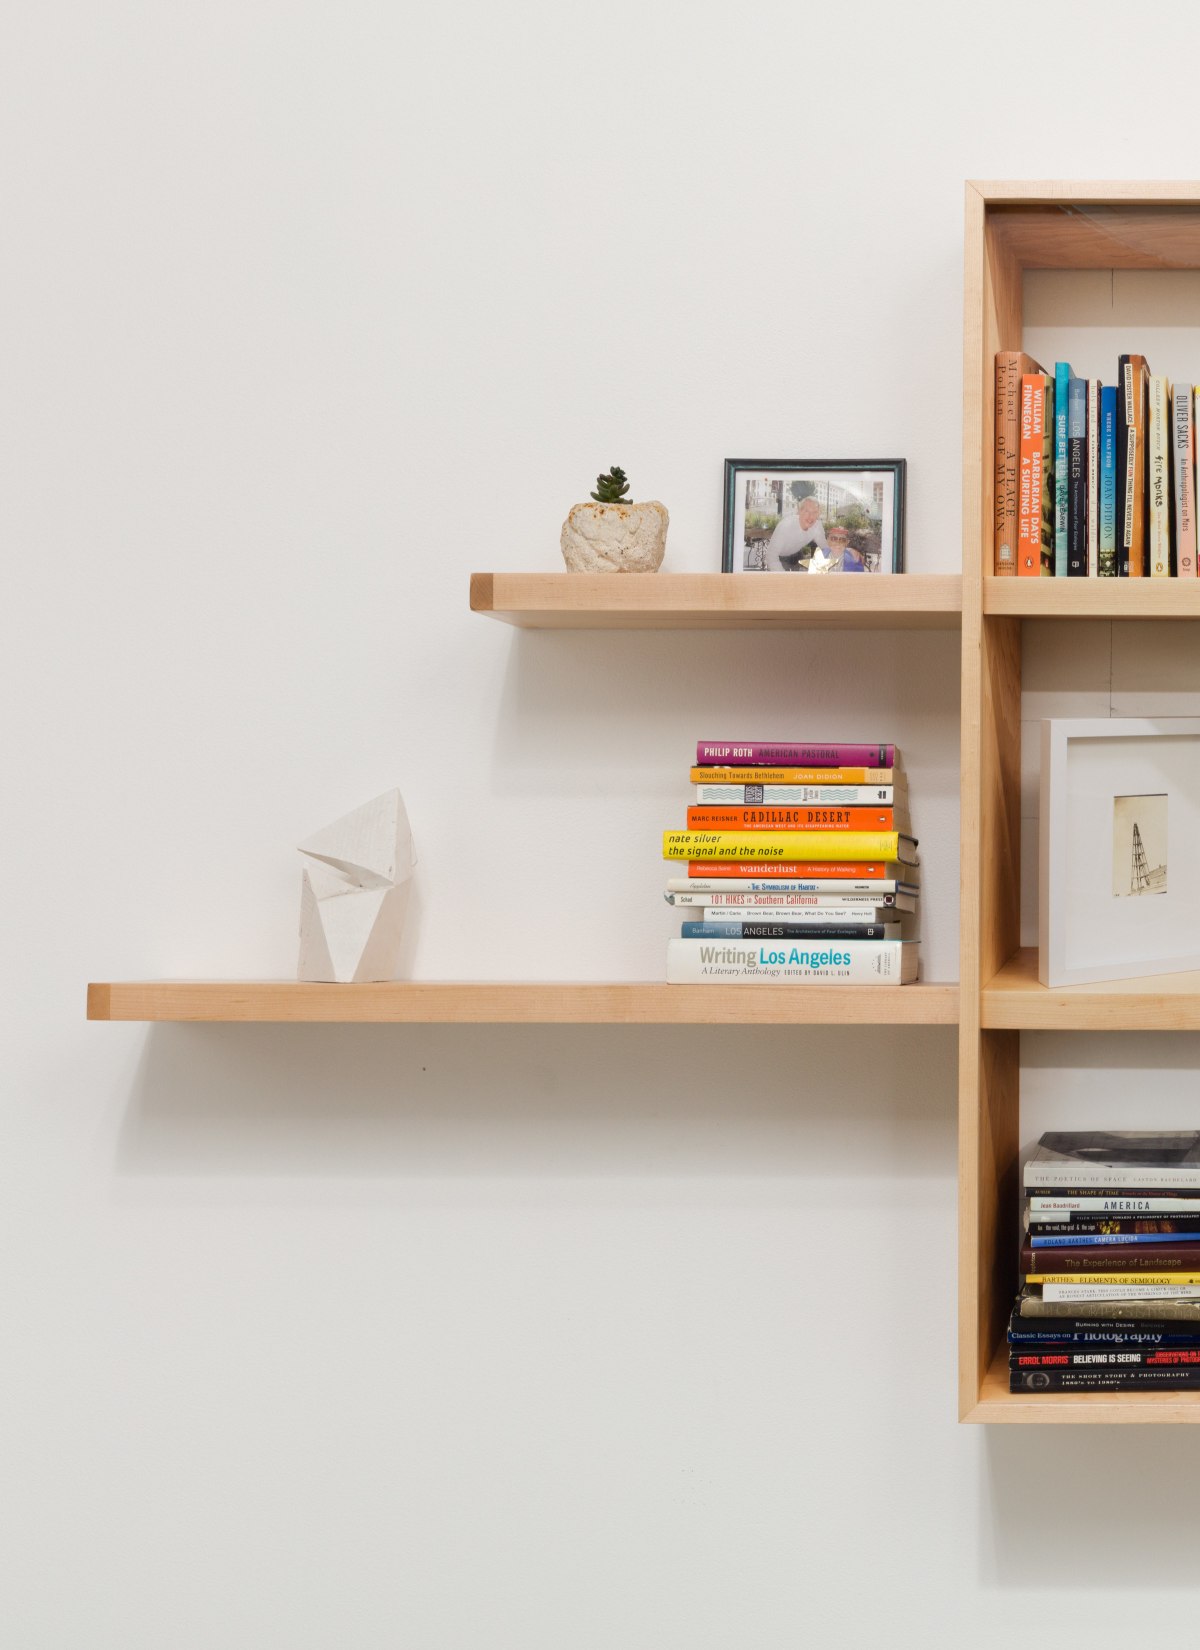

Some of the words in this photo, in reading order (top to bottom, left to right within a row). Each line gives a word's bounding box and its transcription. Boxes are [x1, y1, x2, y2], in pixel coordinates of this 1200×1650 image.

[998, 366, 1006, 416] Pollan
[1009, 359, 1017, 422] Michael
[1023, 385, 1032, 439] FINNEGAN
[1033, 389, 1042, 434] WILLIAM
[1177, 395, 1188, 422] OLIVER
[1072, 421, 1080, 437] LOS
[1177, 425, 1189, 449] SACKS
[998, 436, 1005, 455] OF
[1007, 451, 1015, 460] A
[1022, 457, 1030, 465] A
[1072, 438, 1080, 478] ANGELES
[1155, 455, 1163, 473] fire
[998, 464, 1005, 487] MY
[1032, 451, 1040, 513] BARBARIAN
[1006, 468, 1015, 517] PLACE
[1021, 469, 1030, 515] SURFING
[1154, 477, 1163, 507] Monks
[1180, 466, 1188, 508] Anthropologist
[996, 495, 1004, 531] OWN
[1104, 503, 1112, 539] DIDION
[1021, 520, 1029, 538] LIFE
[1031, 517, 1039, 544] DAYS
[704, 747, 730, 756] PHILIP
[733, 748, 752, 757] ROTH
[758, 749, 798, 757] AMERICAN
[802, 750, 839, 758] PASTORAL
[743, 811, 798, 822] CADILLAC
[808, 811, 850, 822] DESERT
[694, 834, 721, 842] silver
[669, 847, 684, 855] the
[687, 847, 716, 857] signal
[719, 847, 737, 855] and
[739, 847, 755, 855] the
[758, 847, 783, 855] noise
[740, 864, 797, 872] wanderlust
[711, 895, 723, 904] 101
[726, 895, 744, 904] HIKES
[754, 895, 783, 904] Southern
[786, 895, 818, 904] California
[700, 947, 756, 967] Writing
[760, 947, 785, 964] Los
[788, 948, 851, 968] Angeles
[709, 967, 740, 976] Literary
[741, 967, 780, 977] Anthology
[1065, 1259, 1080, 1267] The
[1083, 1259, 1126, 1268] Experience
[1140, 1258, 1181, 1268] Landscape
[1019, 1356, 1040, 1365] ERROL
[1042, 1355, 1069, 1364] MORRIS
[1073, 1355, 1107, 1364] BELIEVING
[1109, 1354, 1116, 1363] IS
[1117, 1353, 1141, 1363] SEEING
